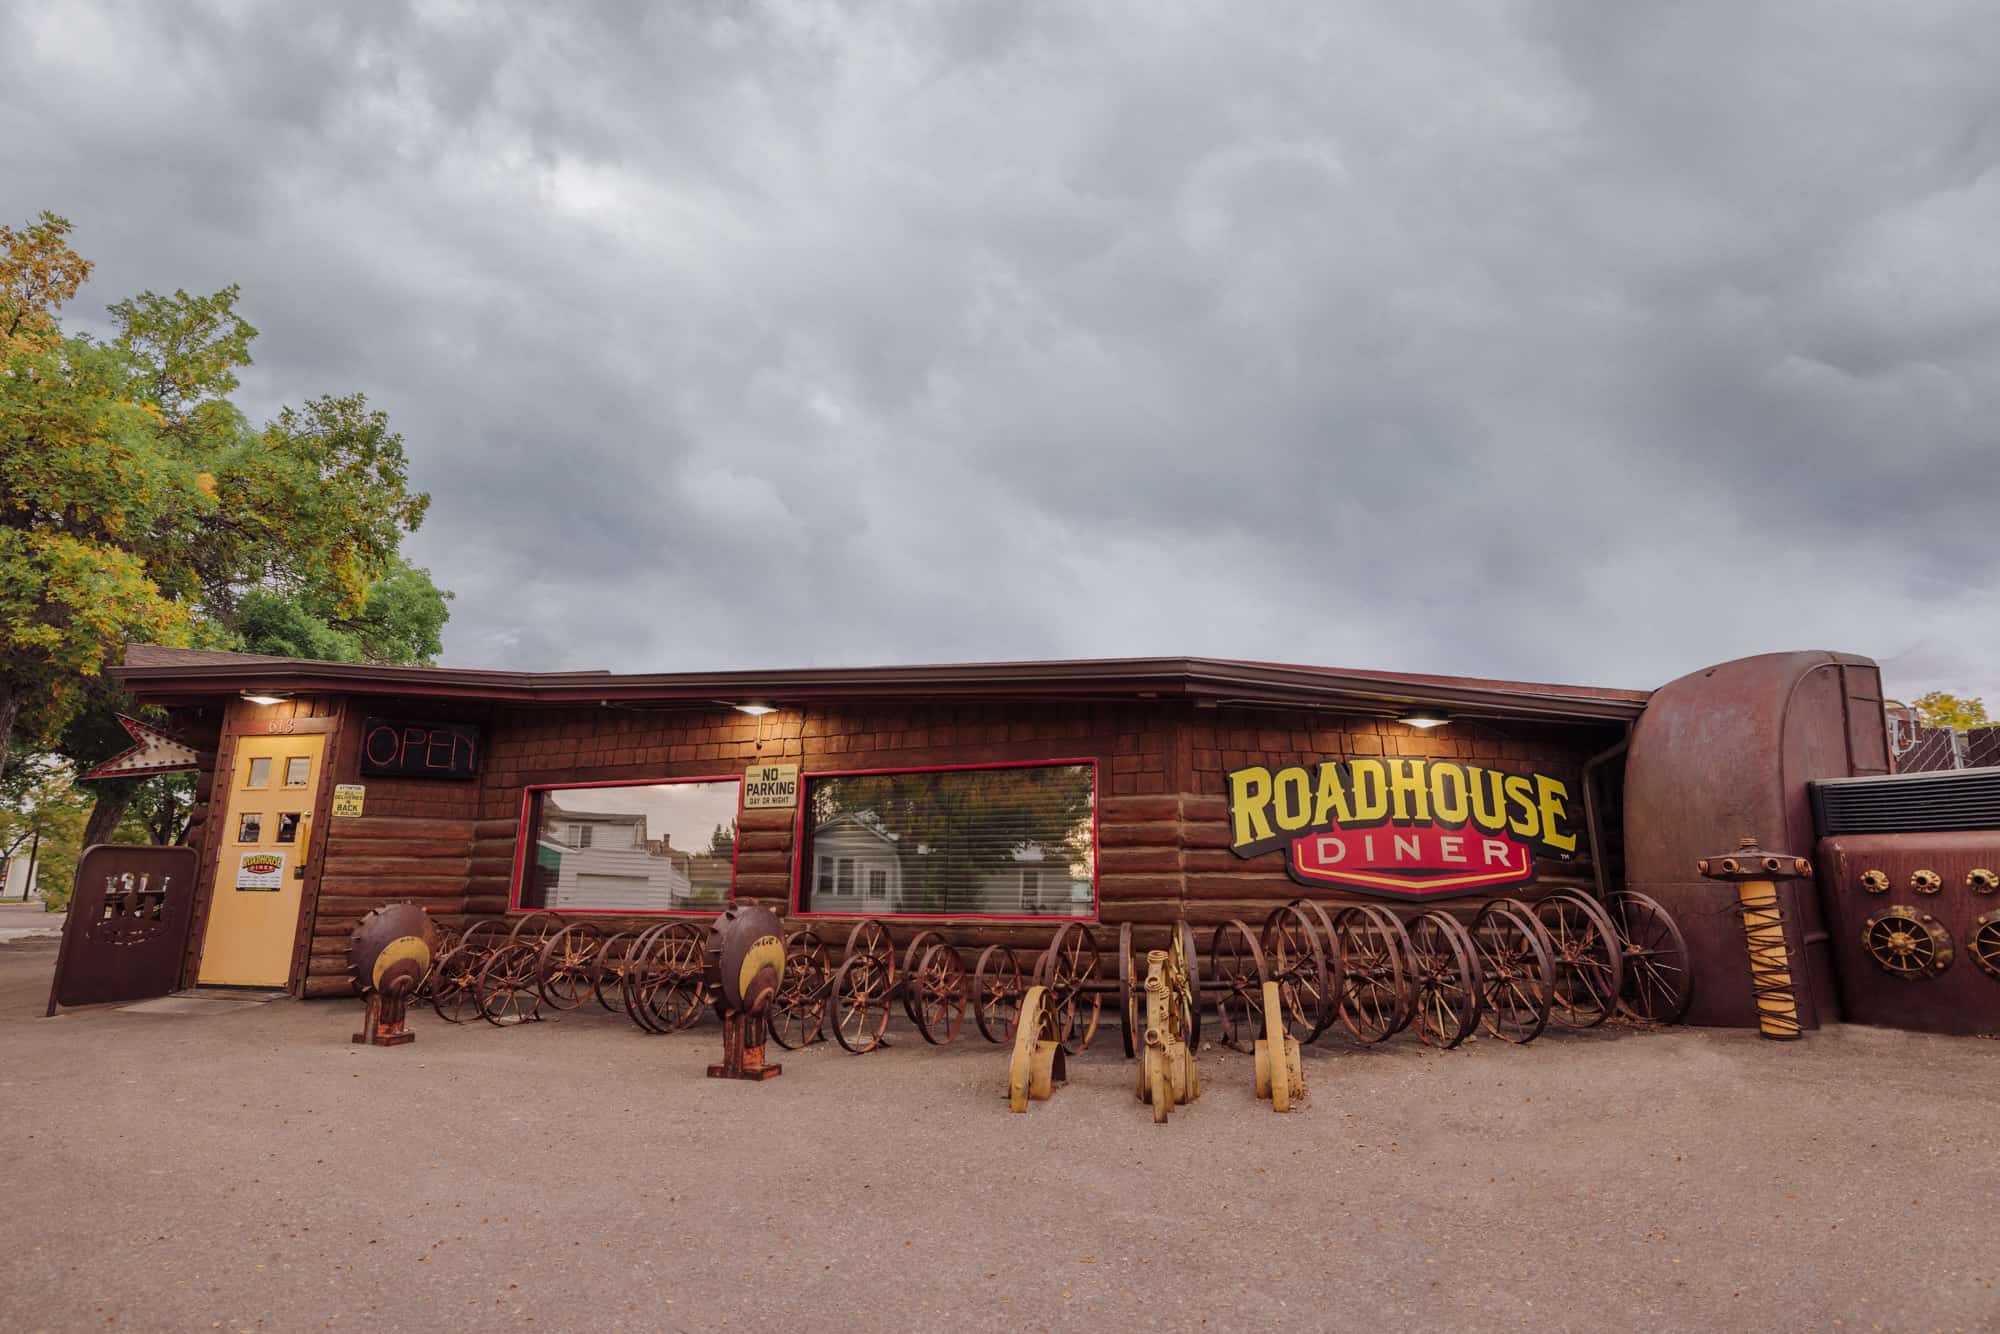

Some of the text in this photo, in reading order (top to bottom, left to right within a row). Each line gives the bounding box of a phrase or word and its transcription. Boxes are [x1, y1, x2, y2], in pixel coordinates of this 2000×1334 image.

[366, 726, 475, 770] OPEN
[762, 768, 779, 782] NO
[746, 782, 795, 796] PARKING
[750, 797, 761, 805] DAY
[772, 796, 789, 804] NIGHT
[1229, 758, 1576, 852] ROADHOUSE
[1316, 834, 1512, 867] DINER
